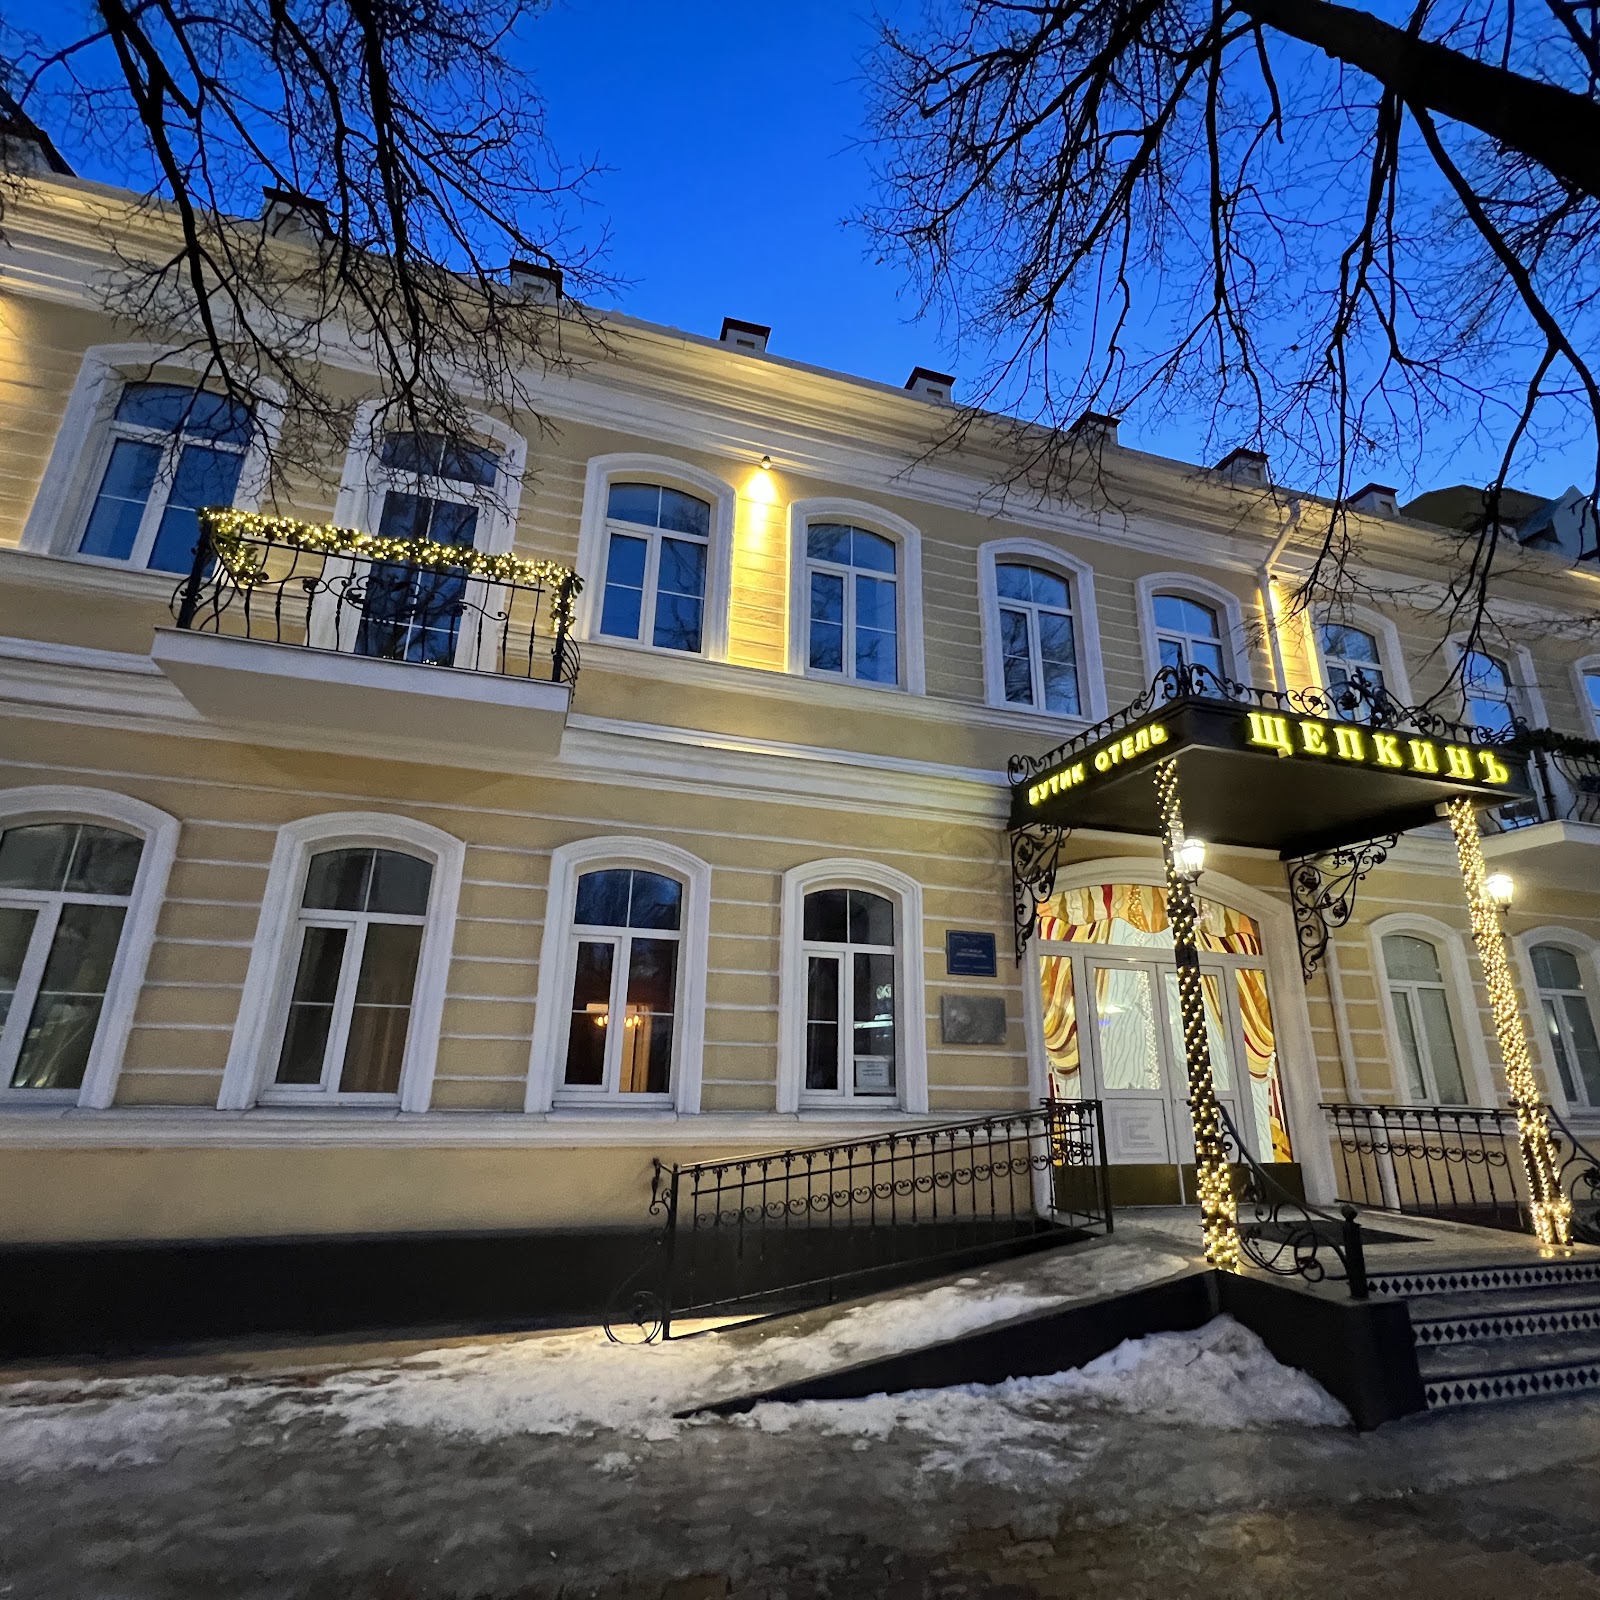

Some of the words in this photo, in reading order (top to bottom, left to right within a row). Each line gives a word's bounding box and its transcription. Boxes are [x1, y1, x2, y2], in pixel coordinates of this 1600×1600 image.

[1028, 763, 1084, 806] БУТИК
[1094, 723, 1168, 772] ОТЕЛЬ
[1245, 711, 1511, 785] ЩЕПКИНЪ
